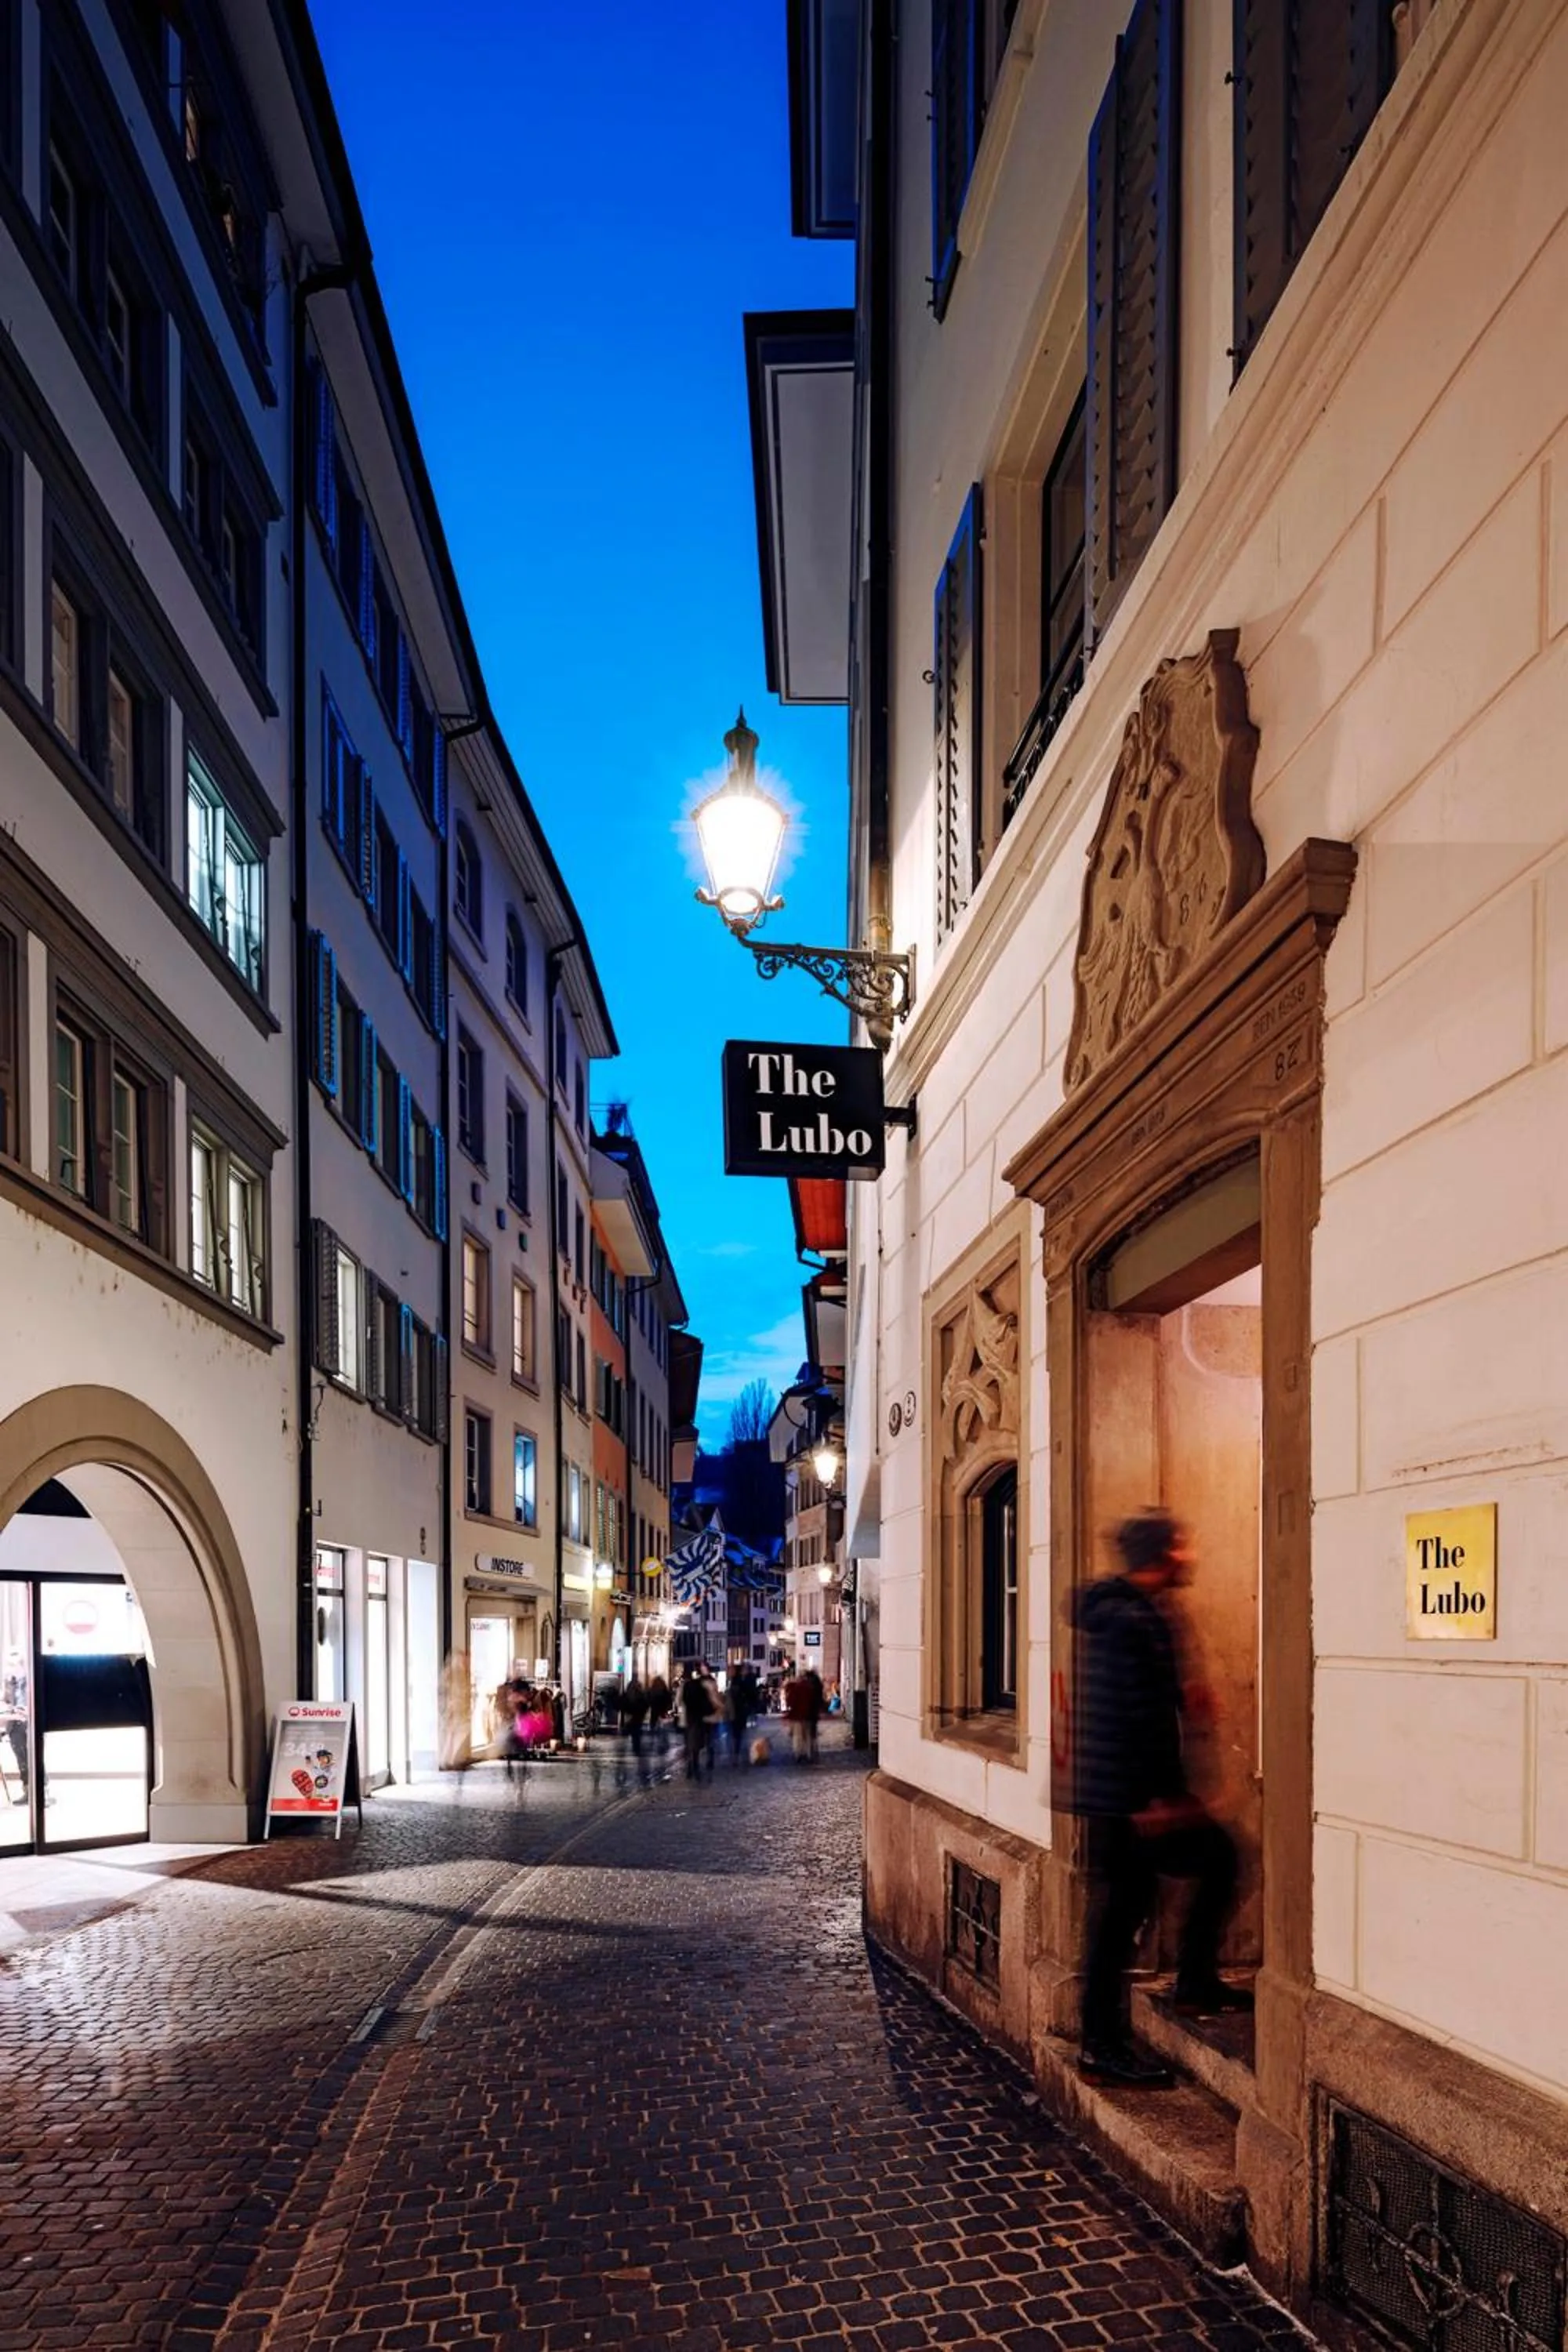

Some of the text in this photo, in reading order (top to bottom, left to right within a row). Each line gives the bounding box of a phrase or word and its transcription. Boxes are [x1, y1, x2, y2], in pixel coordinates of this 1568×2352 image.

[748, 1053, 836, 1098] The
[757, 1111, 873, 1156] Lubo
[492, 1557, 524, 1575] INSTORE
[1416, 1537, 1465, 1570] The
[1420, 1581, 1486, 1614] Lubo
[301, 1707, 342, 1717] Sunrise
